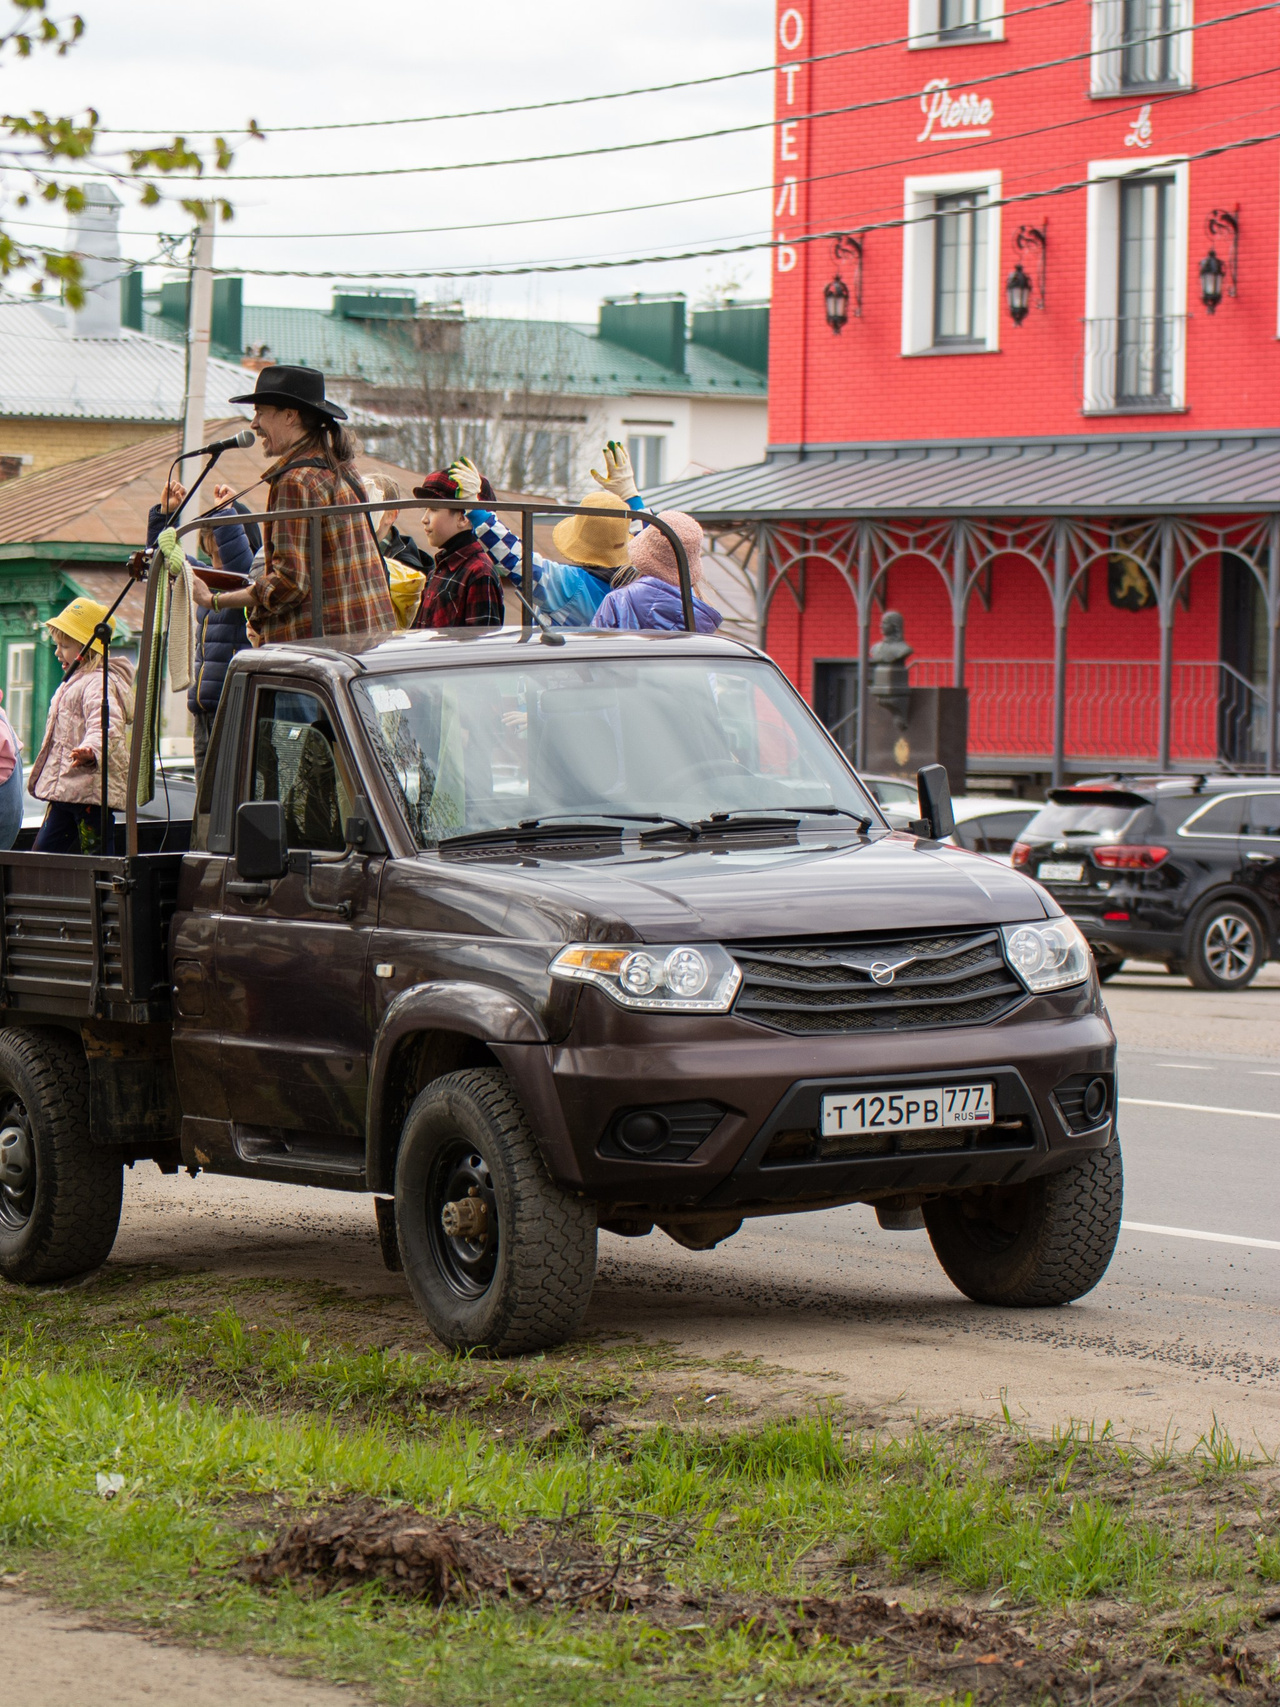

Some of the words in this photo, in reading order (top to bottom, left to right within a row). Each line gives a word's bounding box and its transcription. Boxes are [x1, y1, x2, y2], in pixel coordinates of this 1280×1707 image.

[775, 8, 804, 272] ОТЕЛЬ
[916, 77, 994, 142] Pierre
[1124, 103, 1152, 149] Le
[832, 1095, 939, 1129] Т125РВ
[944, 1087, 984, 1112] 777
[953, 1111, 974, 1122] RUS
